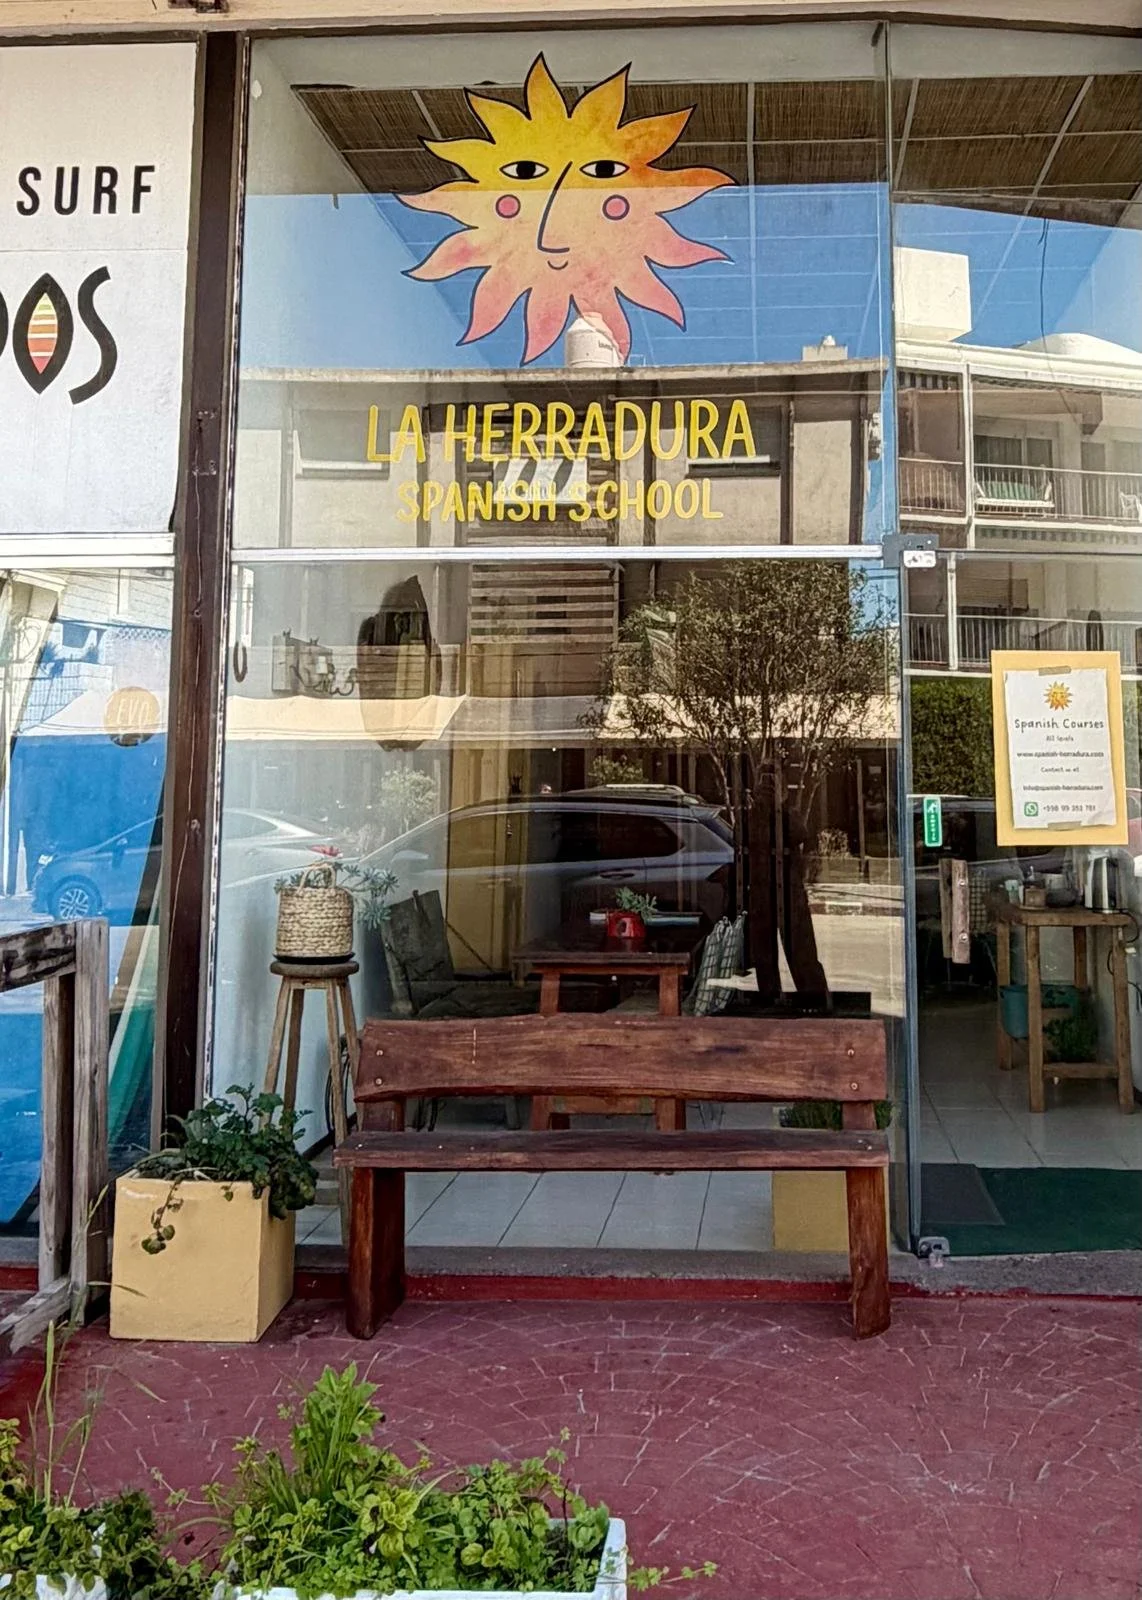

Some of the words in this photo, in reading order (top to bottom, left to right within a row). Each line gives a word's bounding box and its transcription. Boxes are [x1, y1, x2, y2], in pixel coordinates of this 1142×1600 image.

[16, 165, 156, 216] SURF
[0, 265, 118, 405] OS
[366, 403, 427, 463] LA
[443, 399, 757, 463] HERRADURA
[396, 479, 558, 522] SPANISH
[569, 478, 724, 522] SCHOOL
[1014, 717, 1059, 733] Spanish
[1062, 718, 1104, 729] Courses
